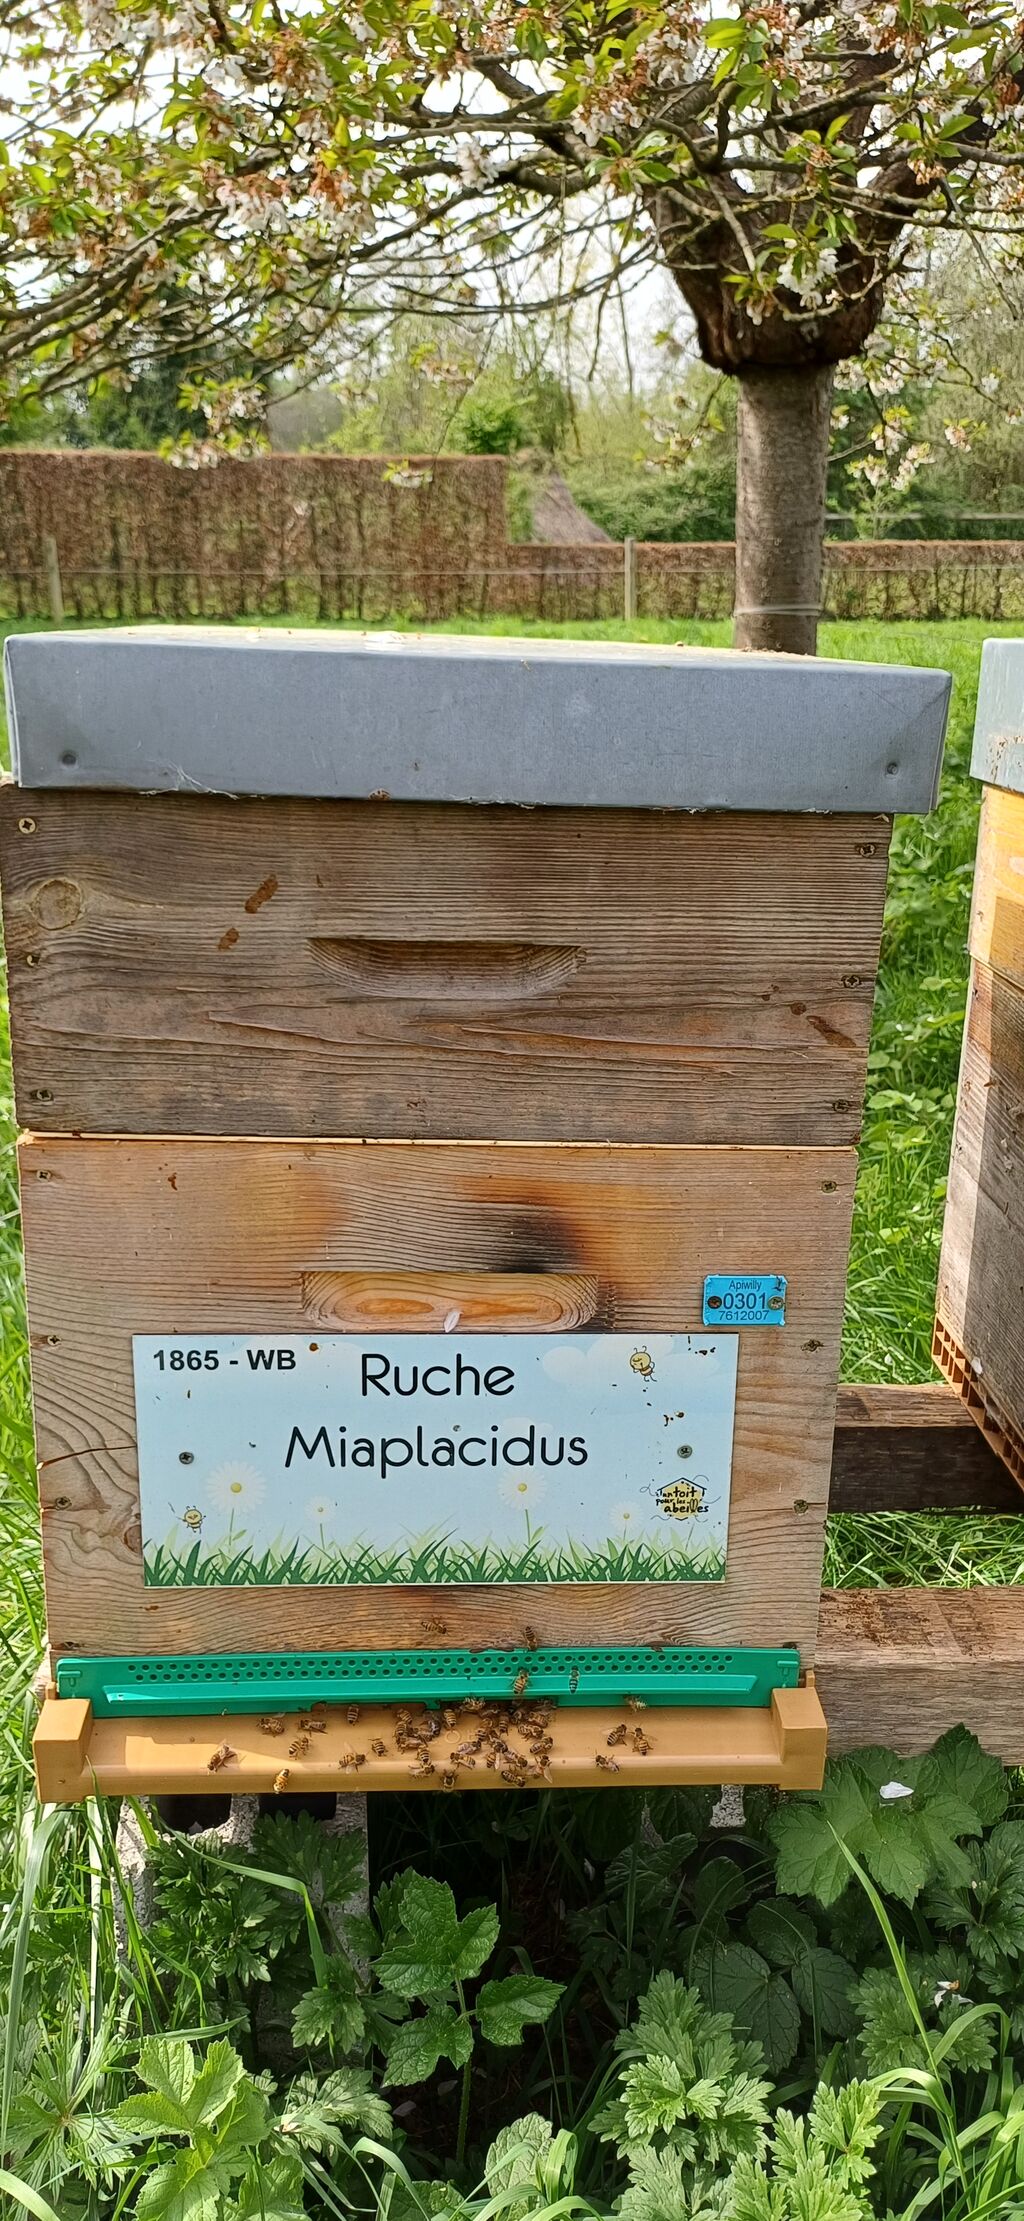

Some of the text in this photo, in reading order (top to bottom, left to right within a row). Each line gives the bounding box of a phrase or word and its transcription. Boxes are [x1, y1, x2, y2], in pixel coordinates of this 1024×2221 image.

[728, 1280, 762, 1292] Apiwilly
[723, 1292, 766, 1310] 0301
[719, 1310, 770, 1321] 7612007
[153, 1349, 219, 1371] 1865
[246, 1349, 297, 1371] WB
[361, 1353, 515, 1396] Ruche
[285, 1425, 589, 1479] Miaplacidus
[673, 1486, 697, 1498] toit
[655, 1498, 673, 1506] pour
[663, 1498, 709, 1513] abeilles
